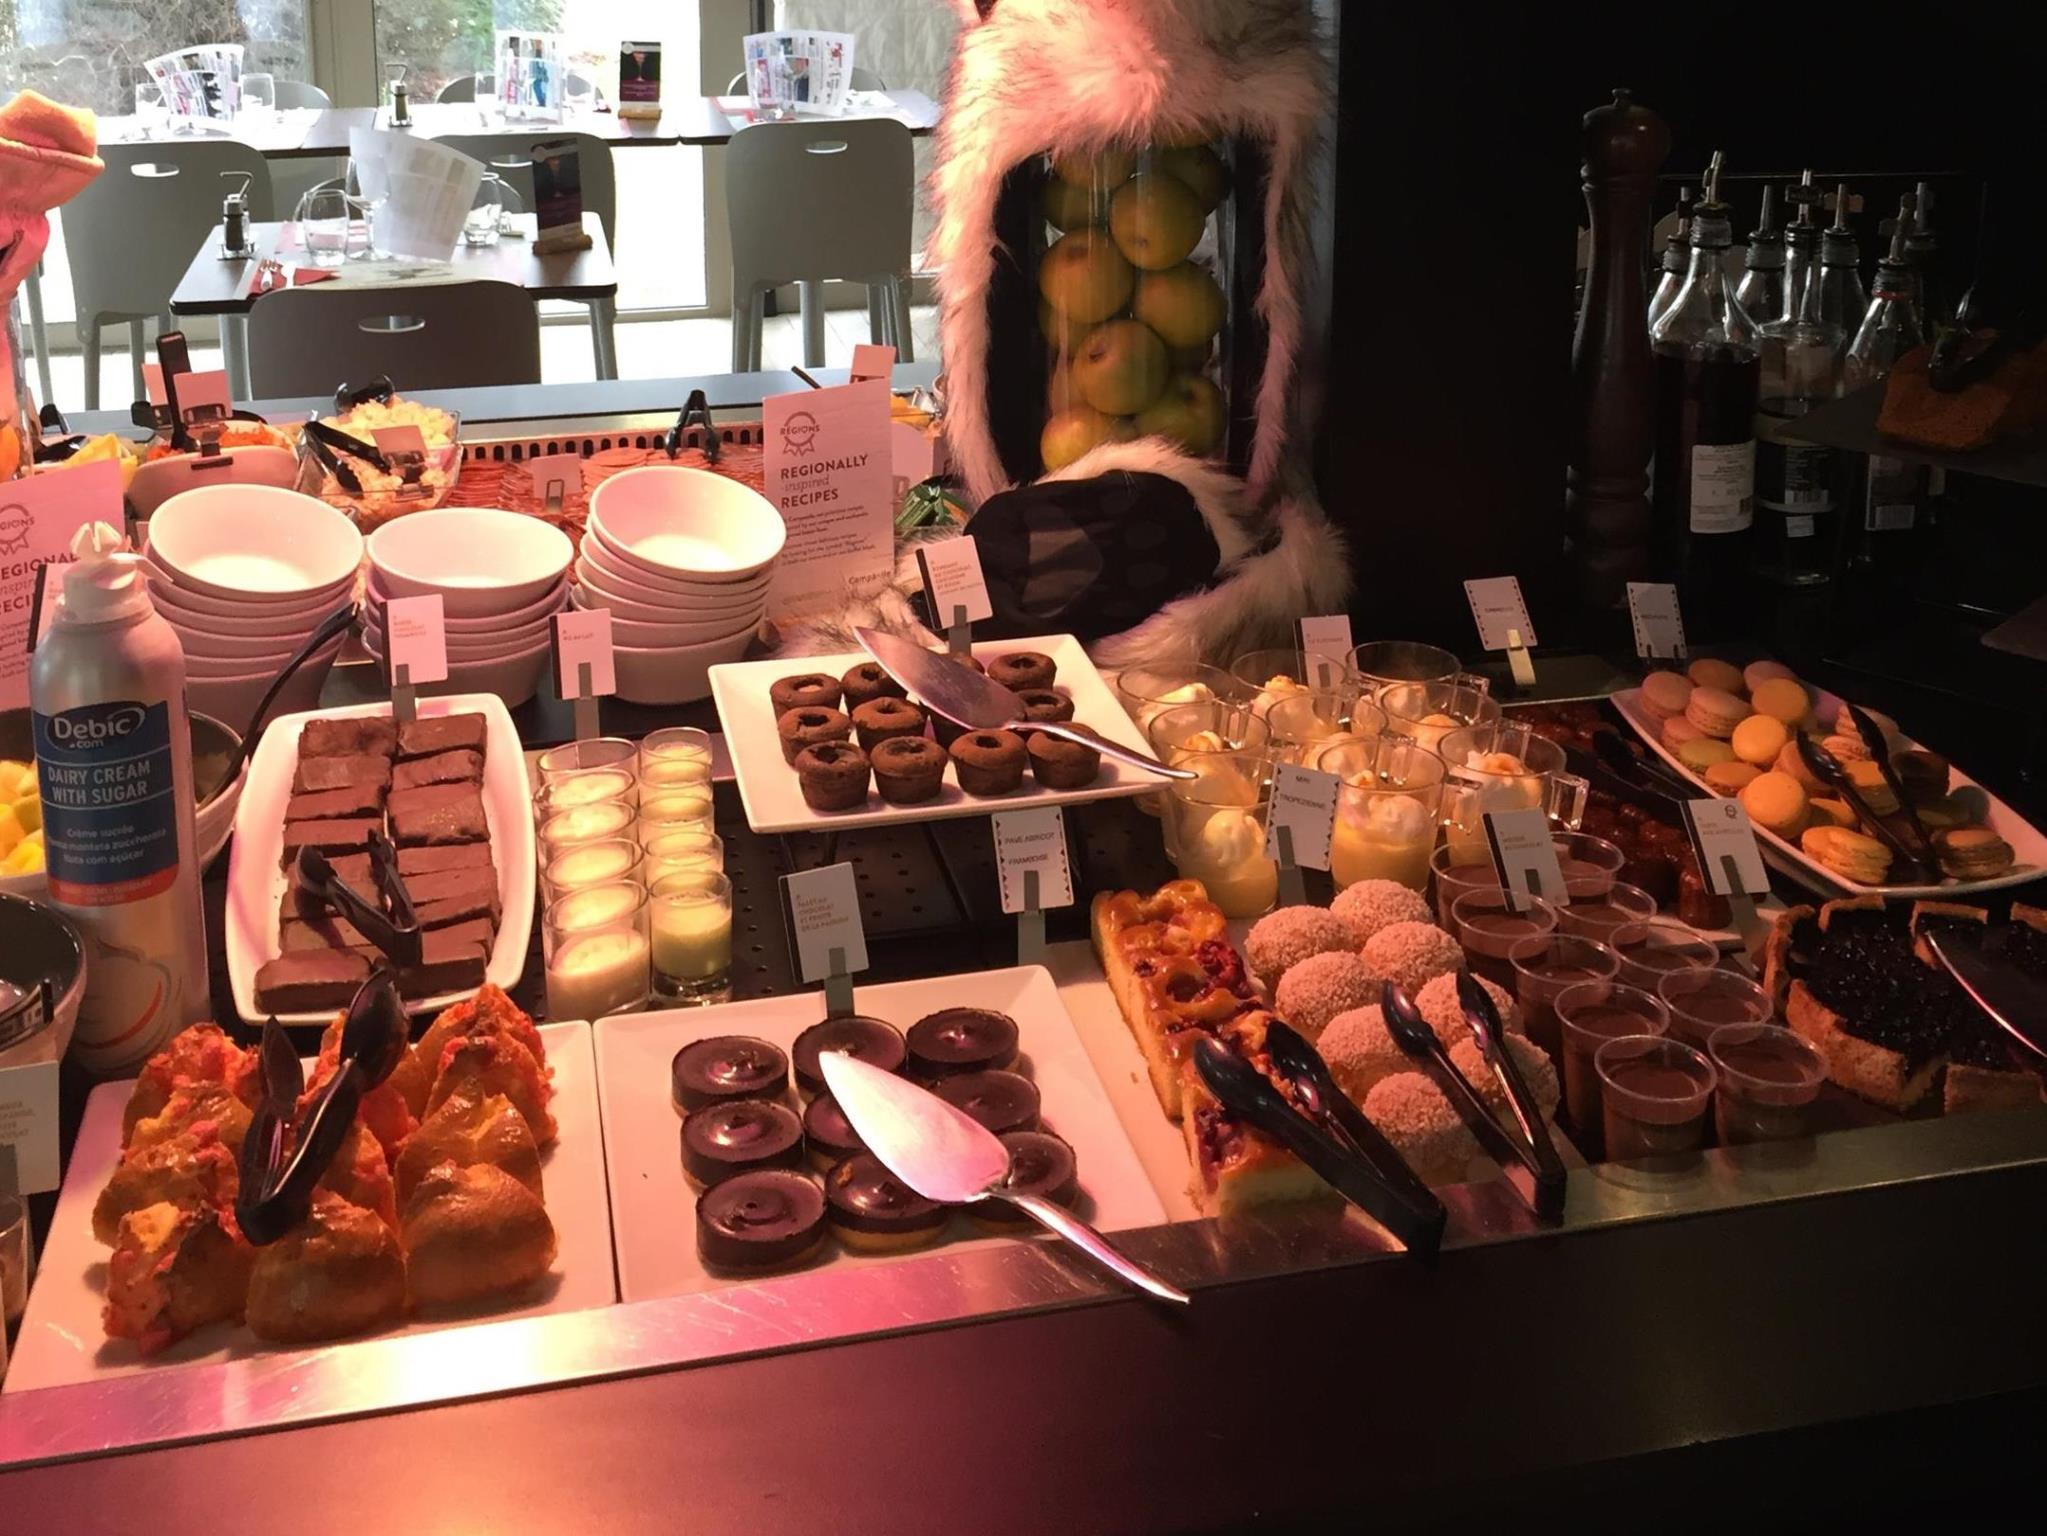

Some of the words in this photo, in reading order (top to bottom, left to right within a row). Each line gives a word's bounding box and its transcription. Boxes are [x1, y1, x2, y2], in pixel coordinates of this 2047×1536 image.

[780, 424, 820, 435] REGIONS
[781, 453, 869, 480] REGIONALLY
[785, 474, 830, 493] inspired
[781, 488, 839, 509] RECIPES
[0, 517, 35, 531] GIONS
[0, 551, 81, 580] EGIONAL
[53, 717, 131, 740] Debic
[69, 740, 105, 750] .com
[47, 766, 88, 785] DAIRY
[93, 760, 151, 784] CREAM
[52, 786, 87, 804] WITH
[91, 780, 148, 804] SUGAR
